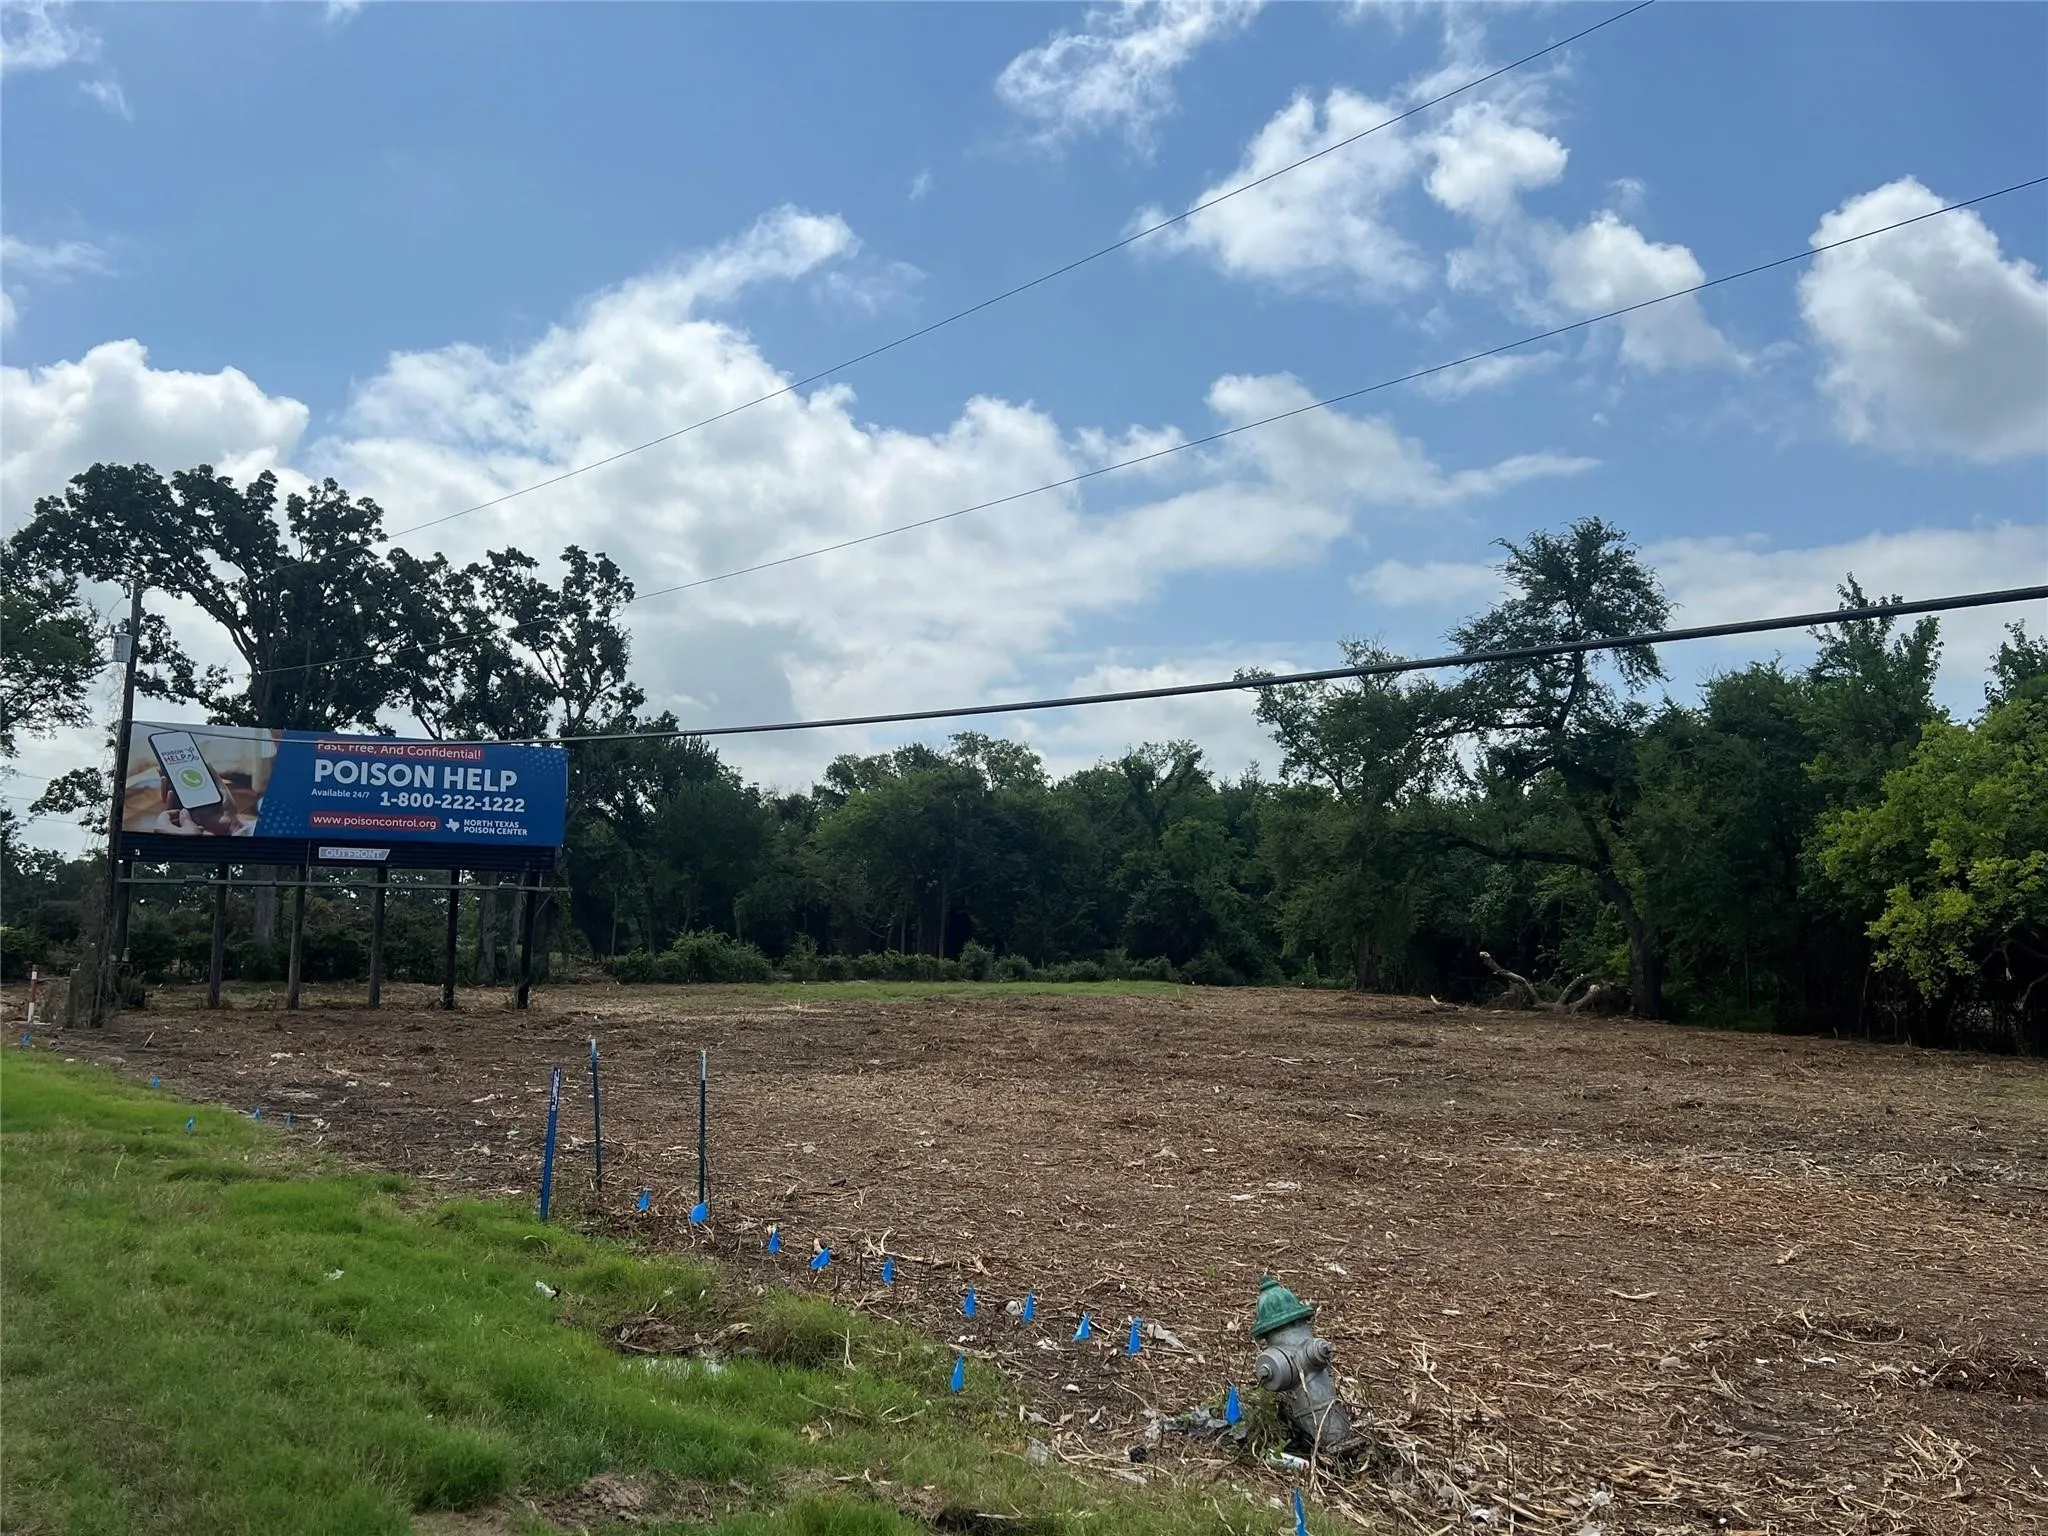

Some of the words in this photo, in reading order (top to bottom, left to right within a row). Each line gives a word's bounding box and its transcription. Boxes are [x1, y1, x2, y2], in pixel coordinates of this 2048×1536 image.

[348, 743, 377, 754] Free,
[380, 744, 404, 755] And
[407, 745, 481, 760] Confidential!
[314, 758, 435, 789] POISON
[443, 766, 518, 793] HELP
[311, 788, 351, 798] Available
[352, 791, 370, 799] 24/7
[380, 791, 525, 813] 1-800-222-1222
[313, 815, 437, 830] www.poisoncontrol.org
[463, 819, 492, 829] NORTH
[494, 820, 520, 829] TEXAS
[463, 826, 495, 835] POISON
[496, 828, 528, 836] CENTER
[325, 848, 381, 859] OUTFRONT
